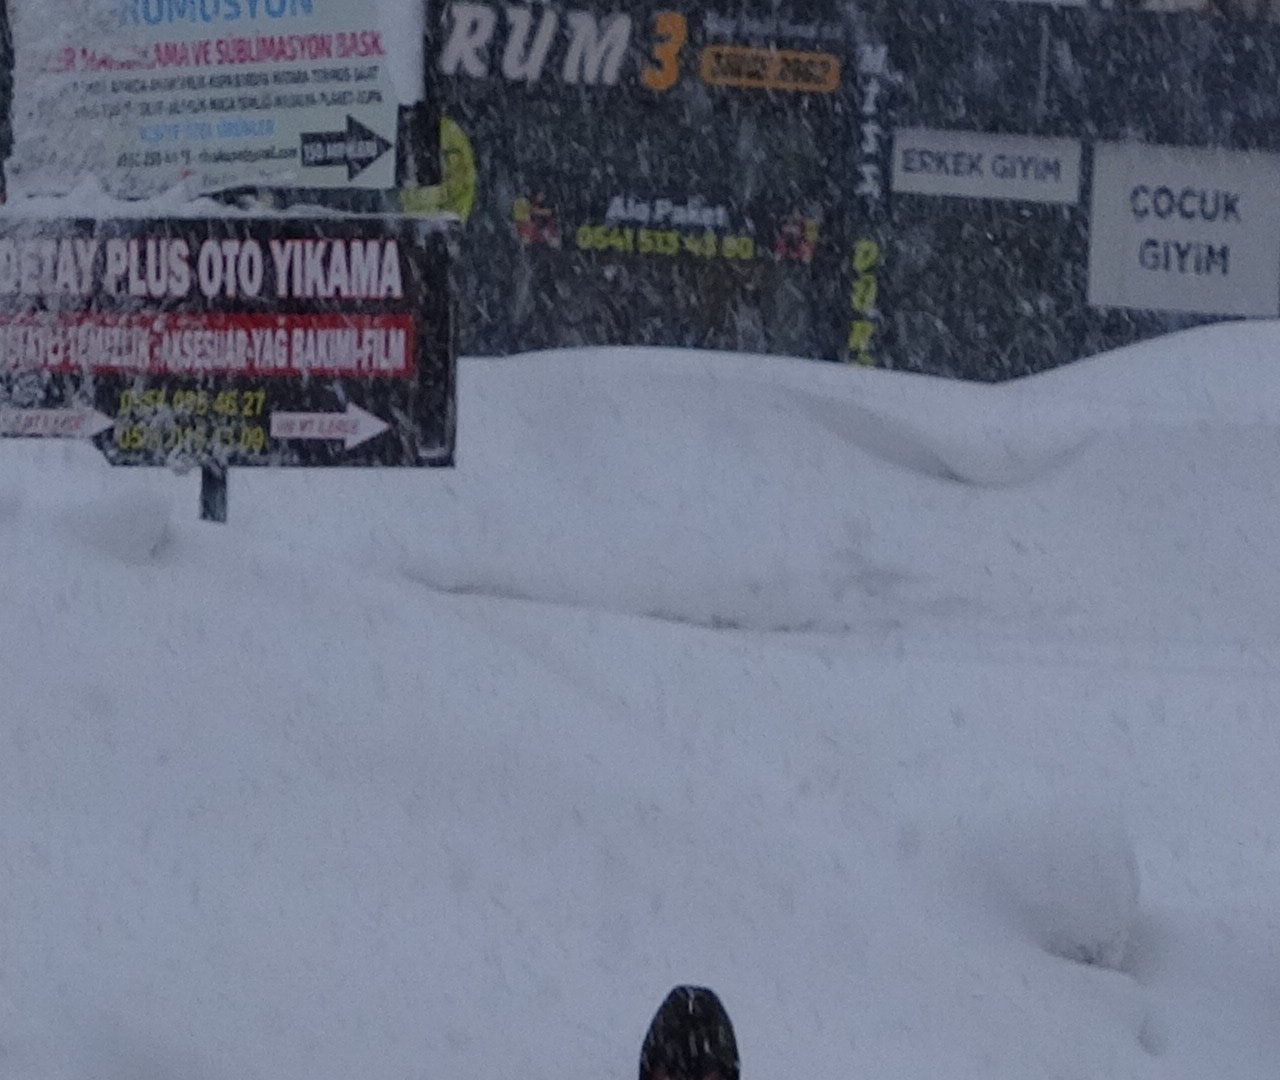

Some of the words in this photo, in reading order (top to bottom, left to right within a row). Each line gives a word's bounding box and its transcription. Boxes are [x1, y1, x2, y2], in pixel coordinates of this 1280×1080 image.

[639, 11, 687, 90] 3
[902, 148, 983, 176] ERKEK
[106, 239, 190, 298] PLUS
[198, 240, 263, 298] OTO
[269, 238, 403, 298] YIKAMA
[242, 389, 266, 416] 27
